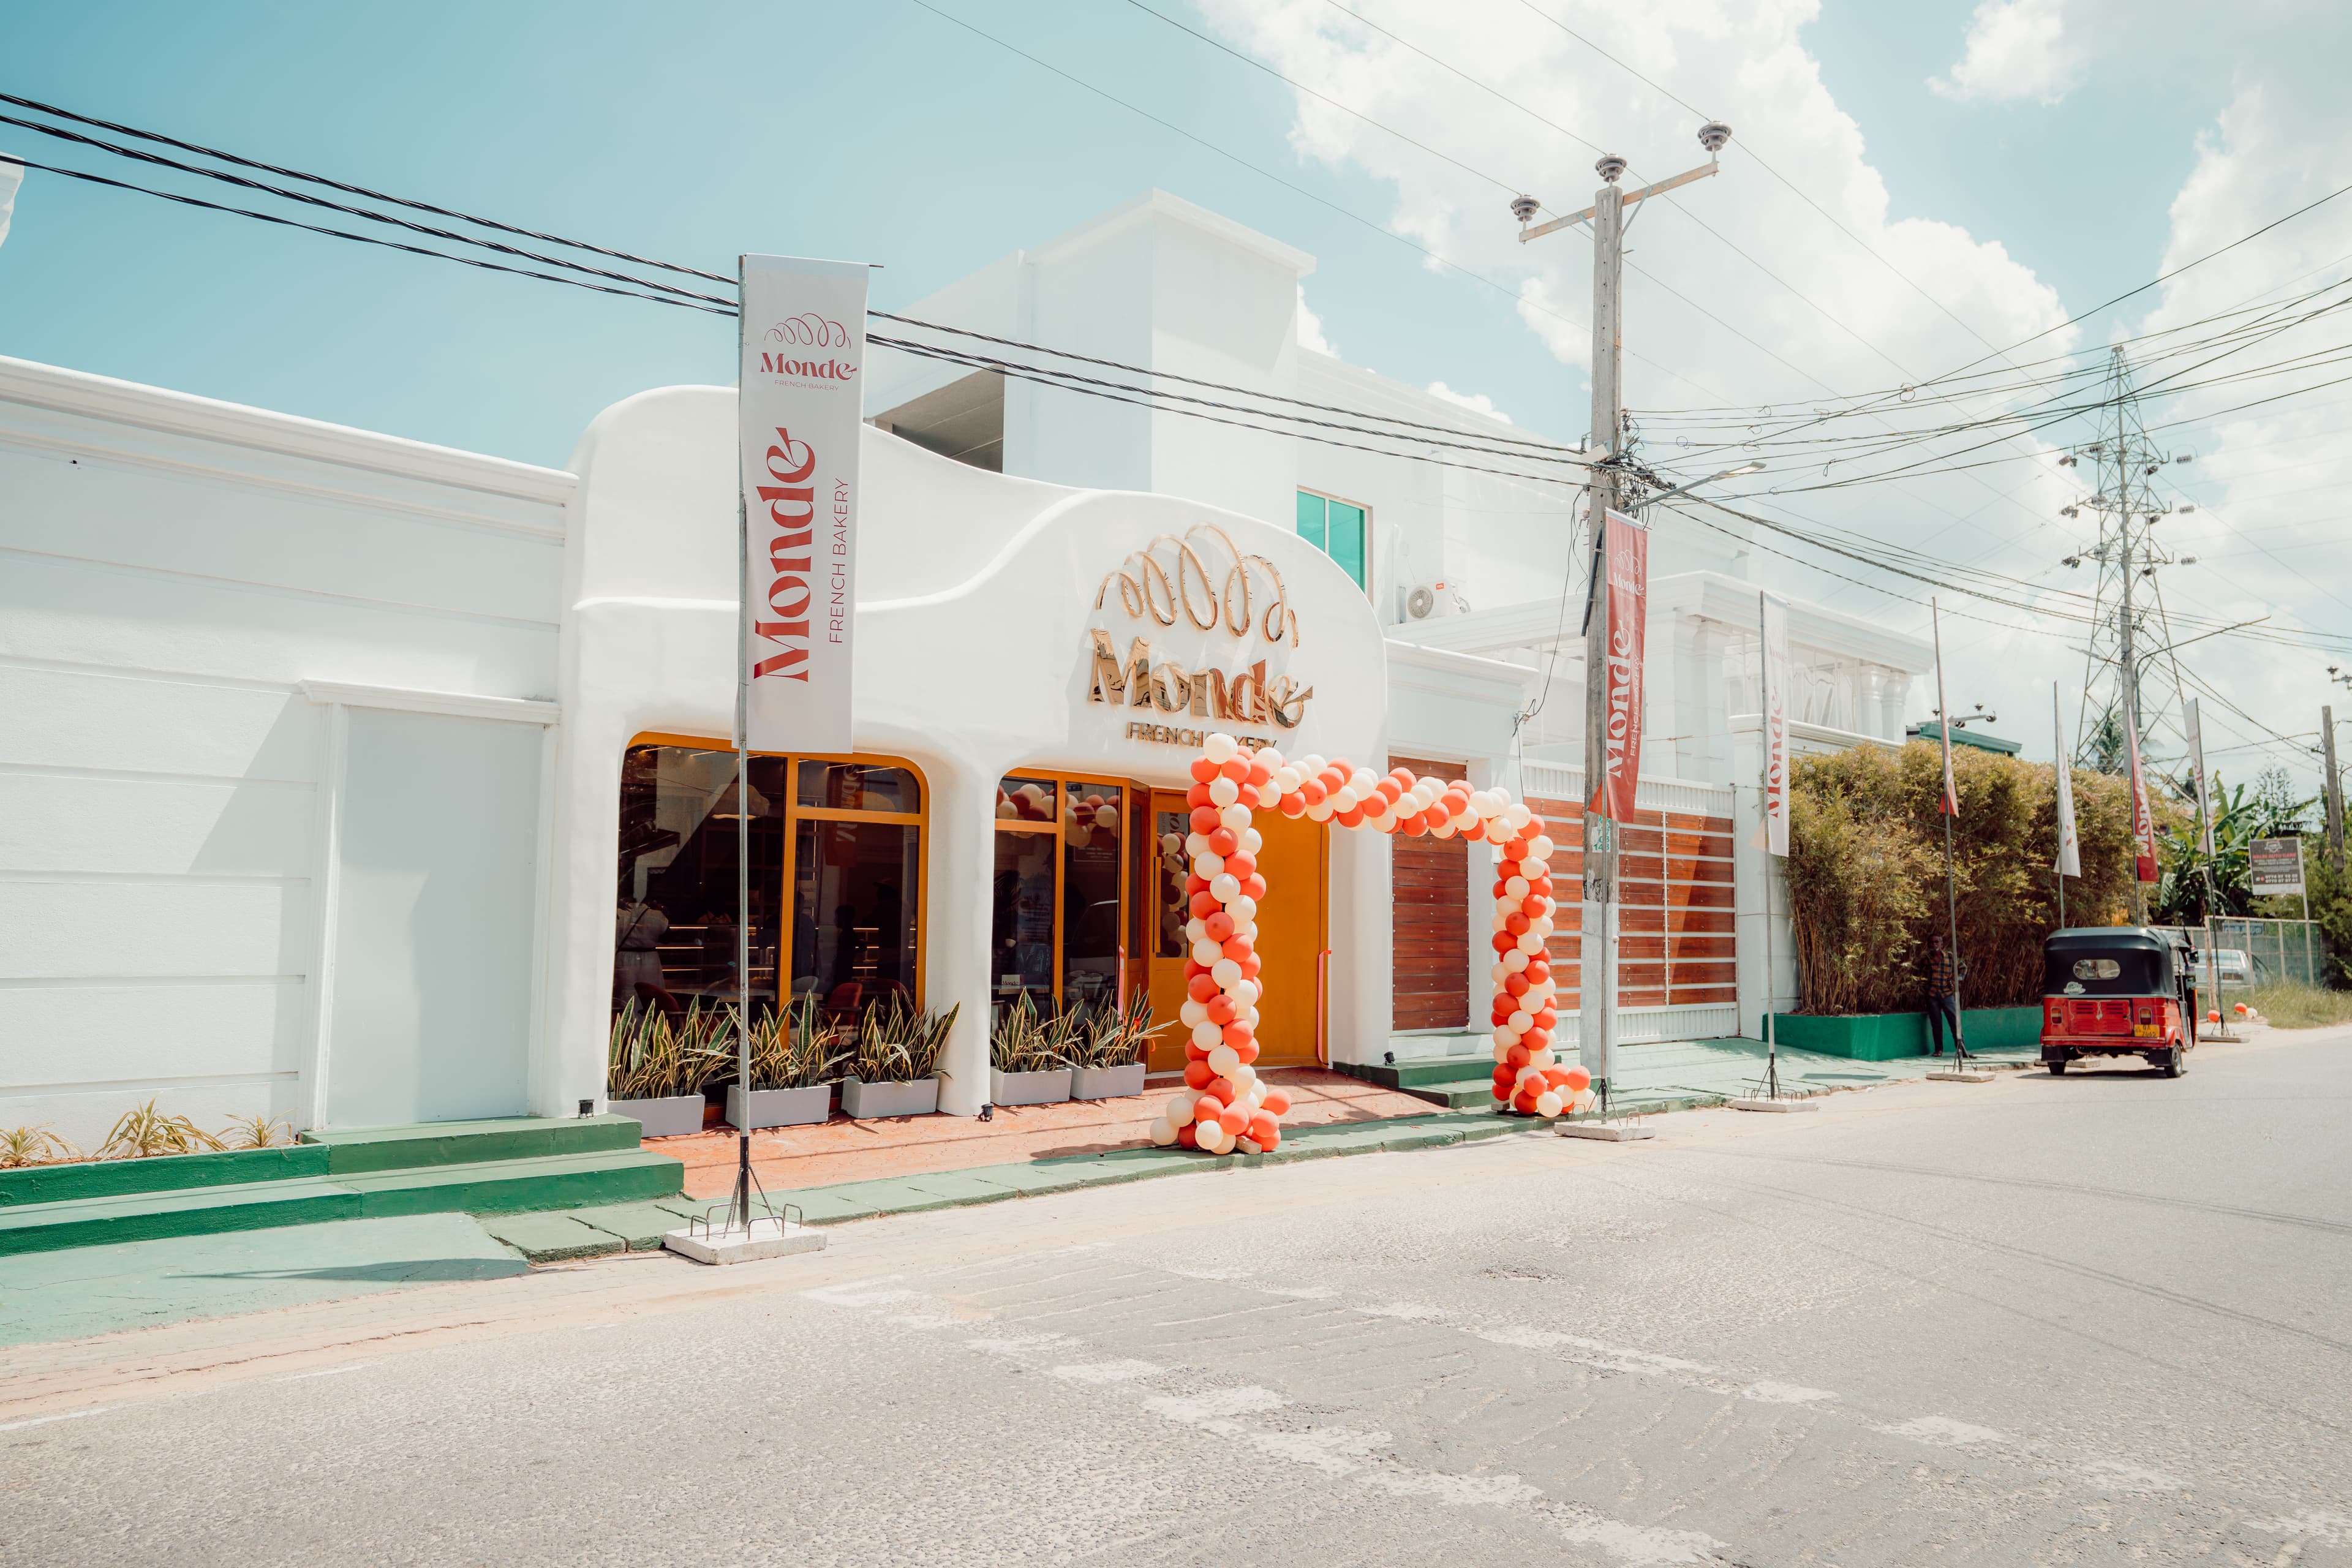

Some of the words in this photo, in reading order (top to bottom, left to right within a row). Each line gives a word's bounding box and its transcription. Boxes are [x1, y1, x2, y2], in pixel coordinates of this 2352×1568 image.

[761, 352, 857, 380] Monde
[775, 379, 806, 388] FRENCH
[754, 427, 815, 682] Monde
[832, 477, 848, 556] BAKERY
[829, 564, 845, 643] FRENCH
[1088, 628, 1313, 729] Monde
[1607, 619, 1632, 778] Monde
[1126, 722, 1204, 748] FRENCH
